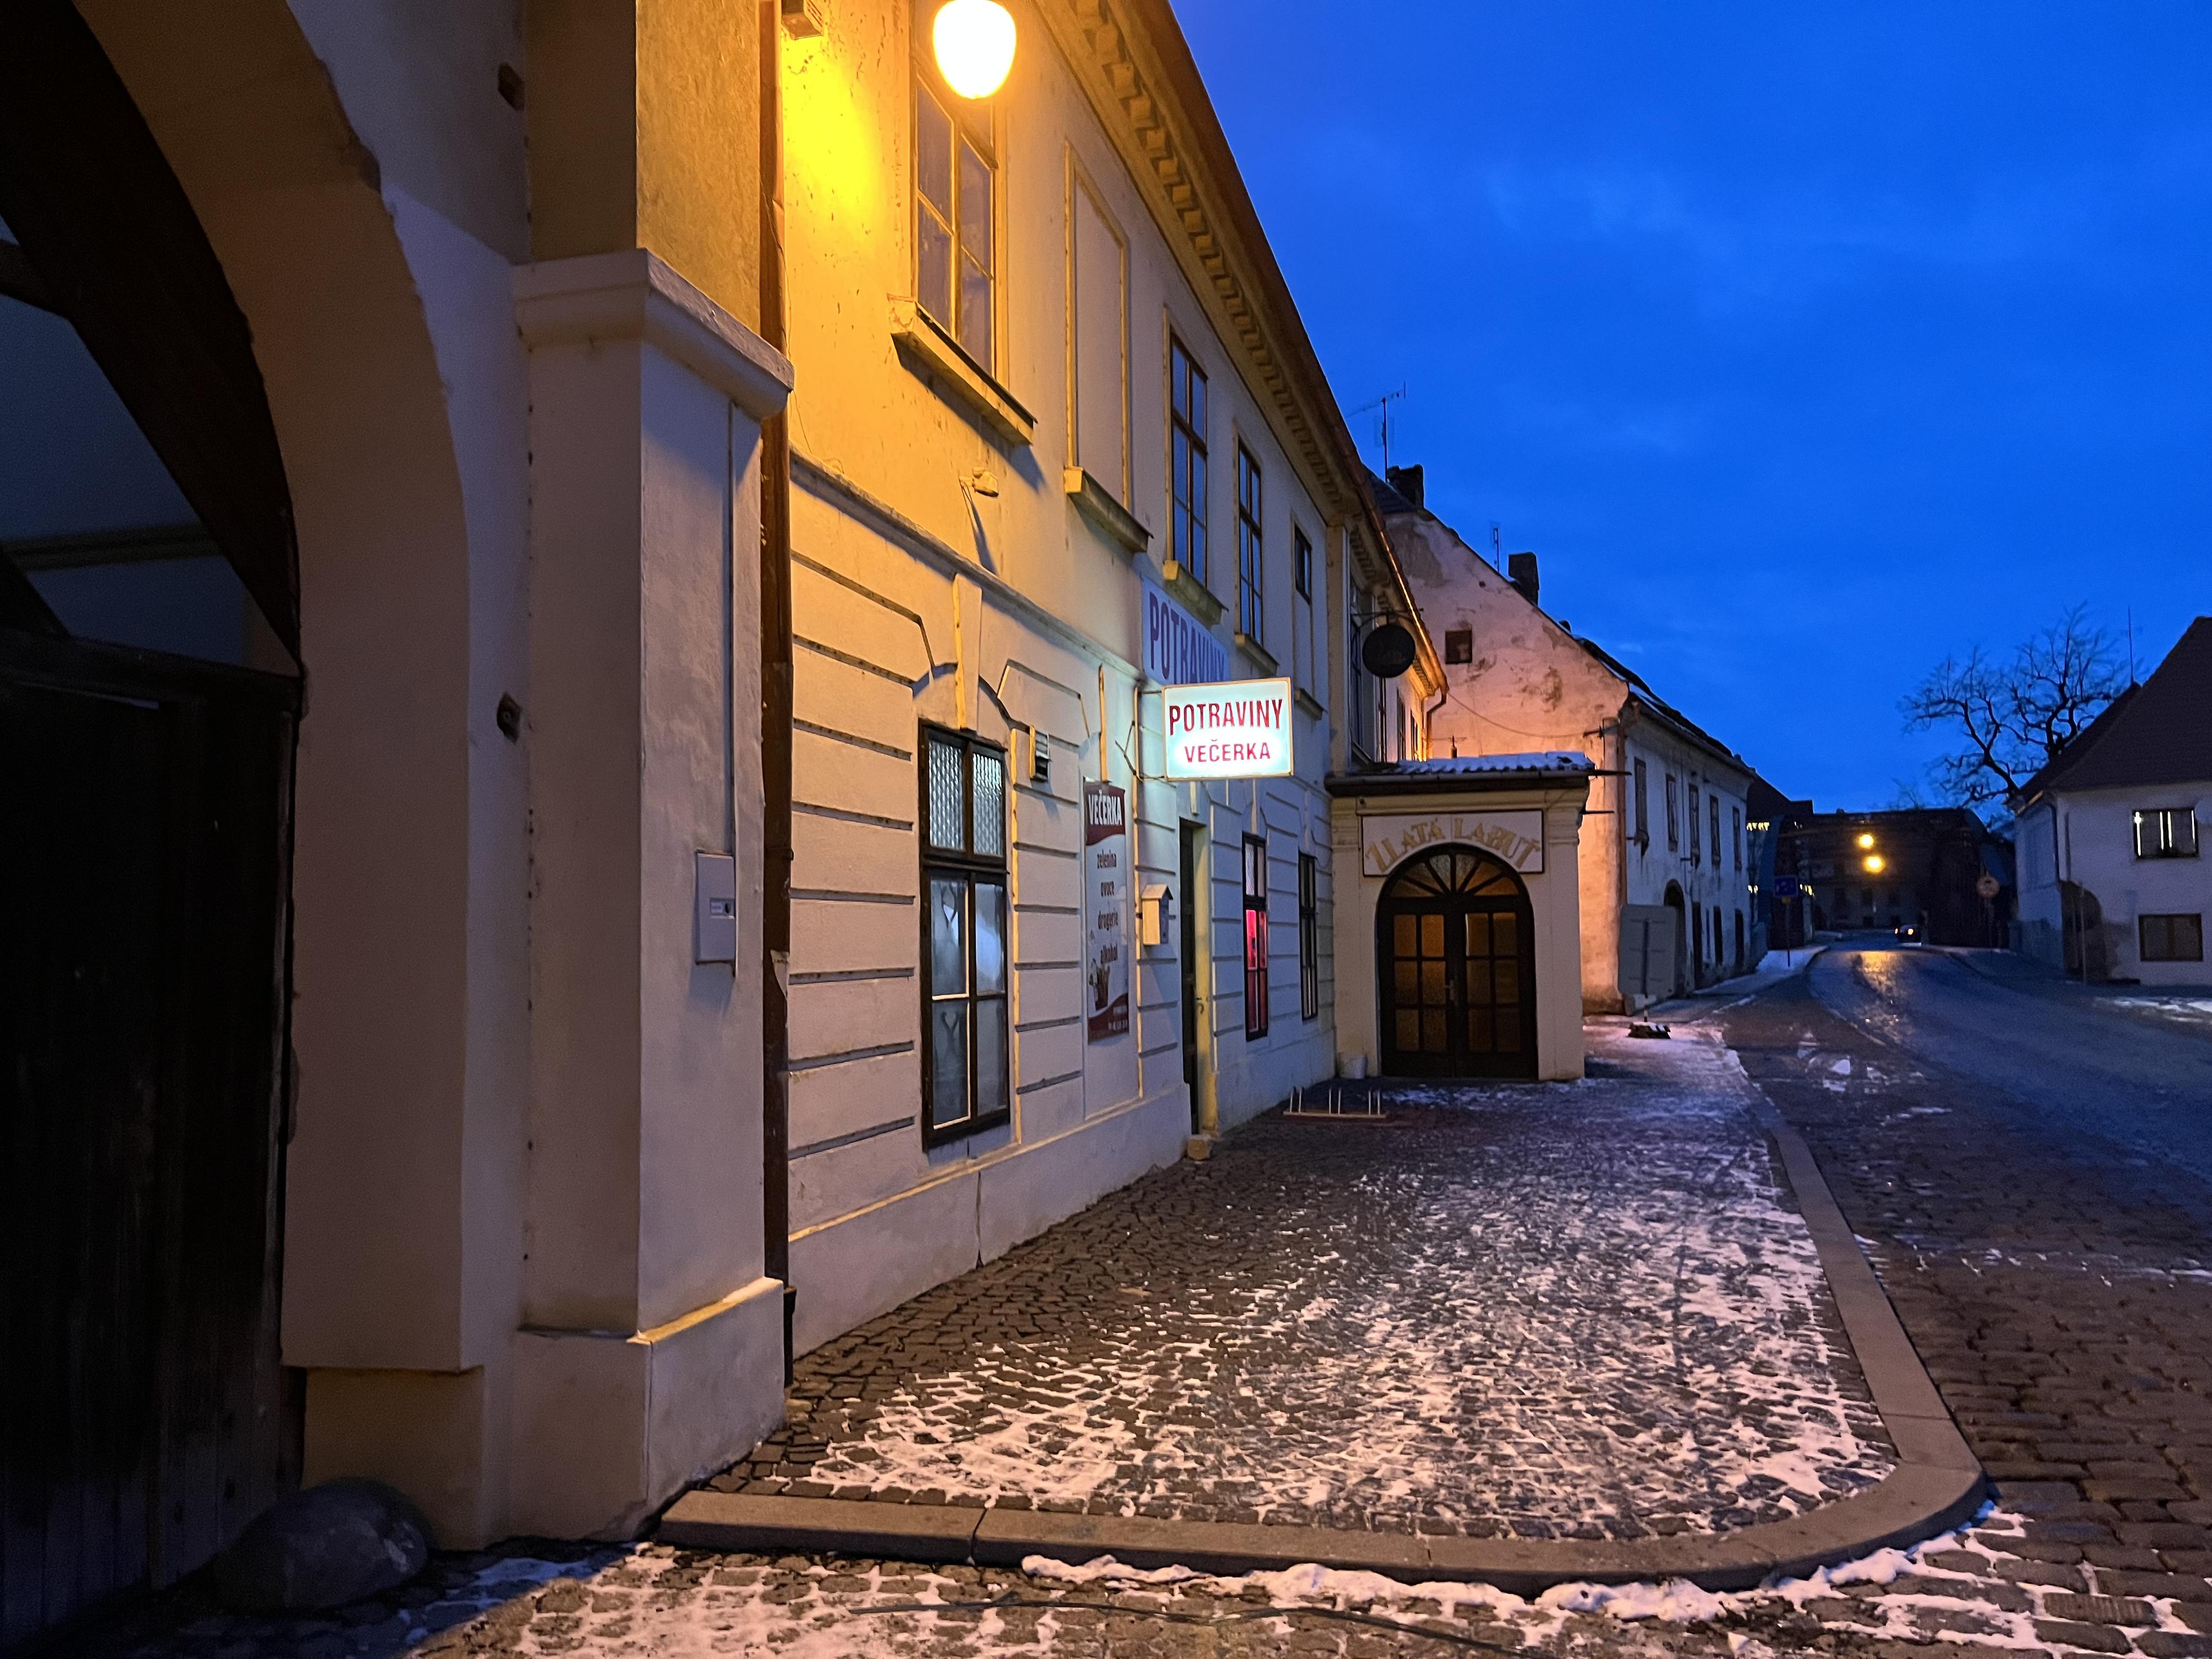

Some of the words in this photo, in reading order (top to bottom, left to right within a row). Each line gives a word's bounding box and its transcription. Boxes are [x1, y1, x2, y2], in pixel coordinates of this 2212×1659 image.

[1168, 699, 1283, 736] POTRAVINY
[1184, 739, 1271, 763] VEČERKA
[1088, 789, 1122, 825] VEČERKA
[1365, 818, 1446, 872] ZLATÁ
